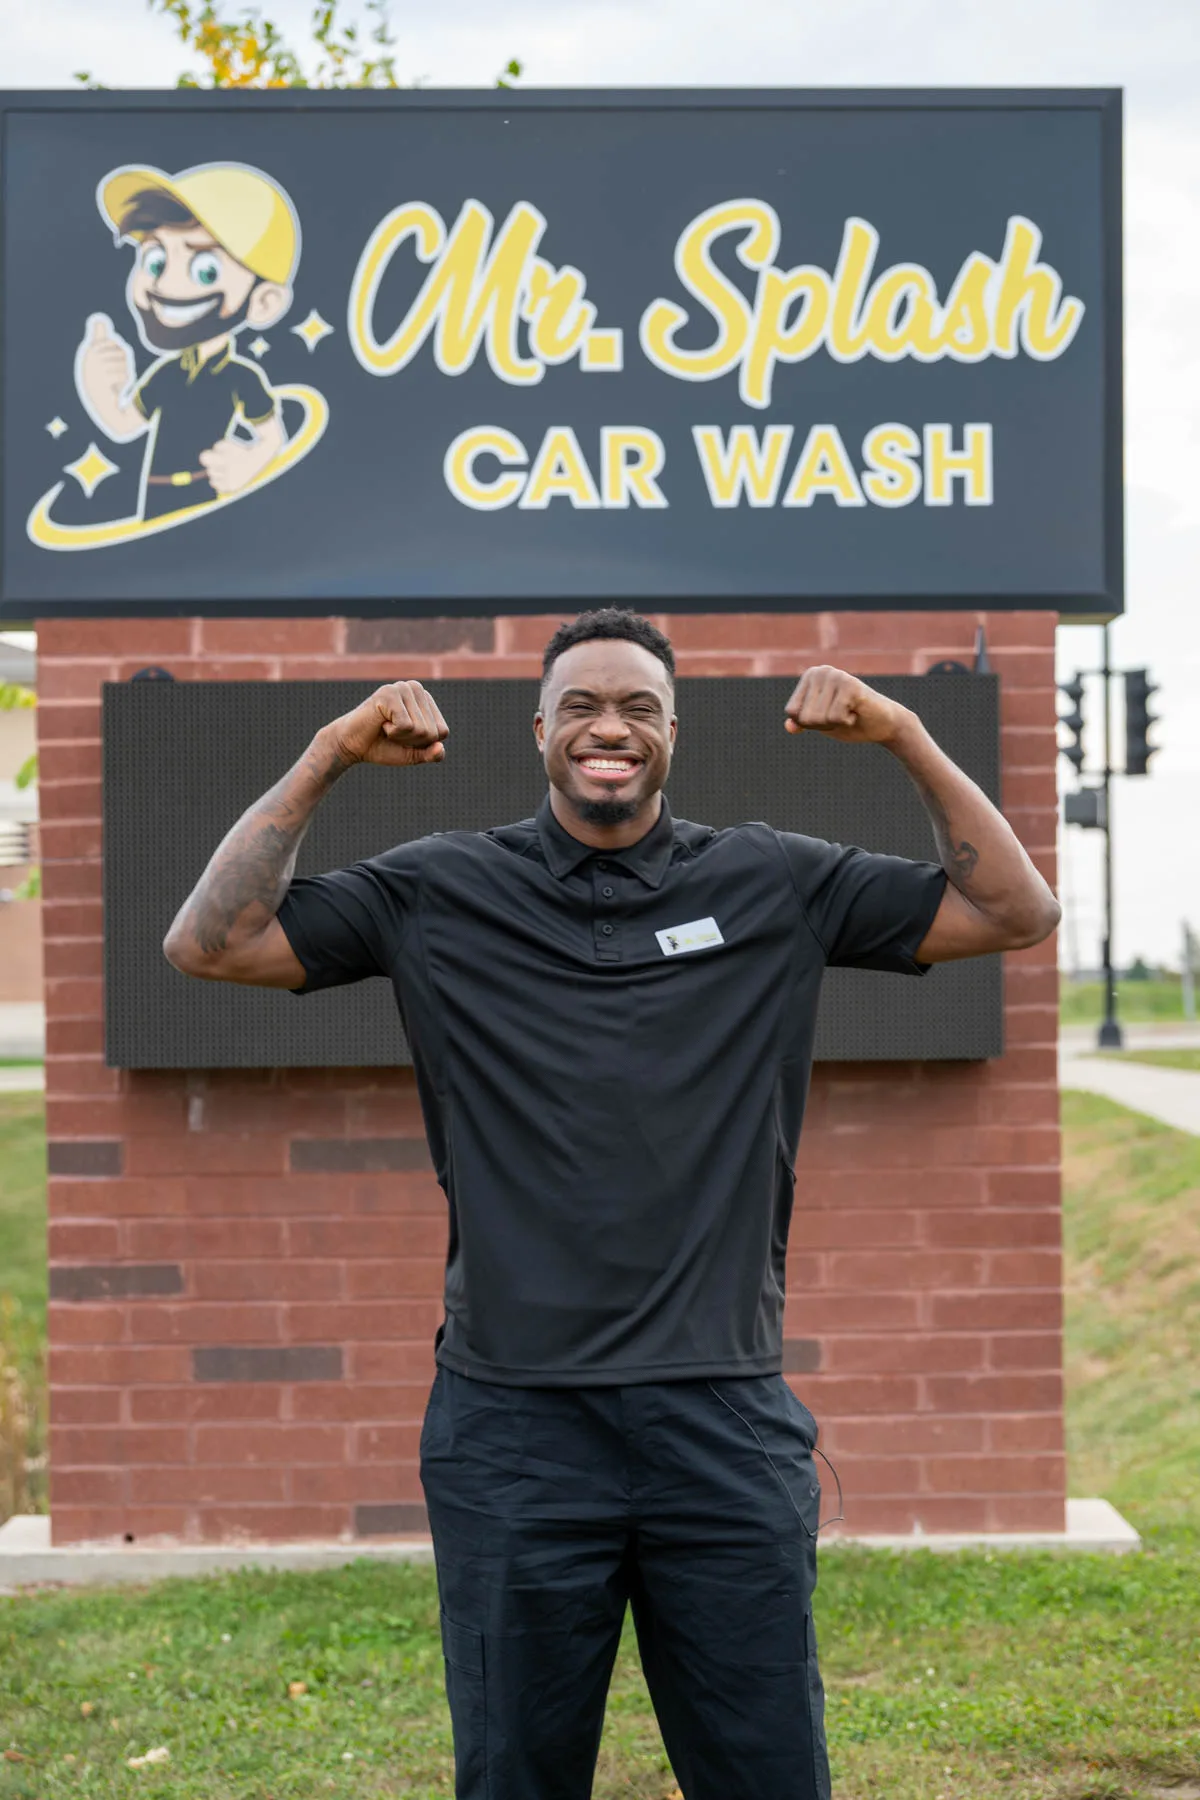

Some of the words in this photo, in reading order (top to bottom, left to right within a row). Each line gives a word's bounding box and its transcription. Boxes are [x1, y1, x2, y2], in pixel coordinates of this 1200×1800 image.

[347, 198, 623, 386] Mr.
[639, 198, 1086, 409] Splash
[443, 425, 669, 511] CAR
[691, 422, 993, 508] WASH
